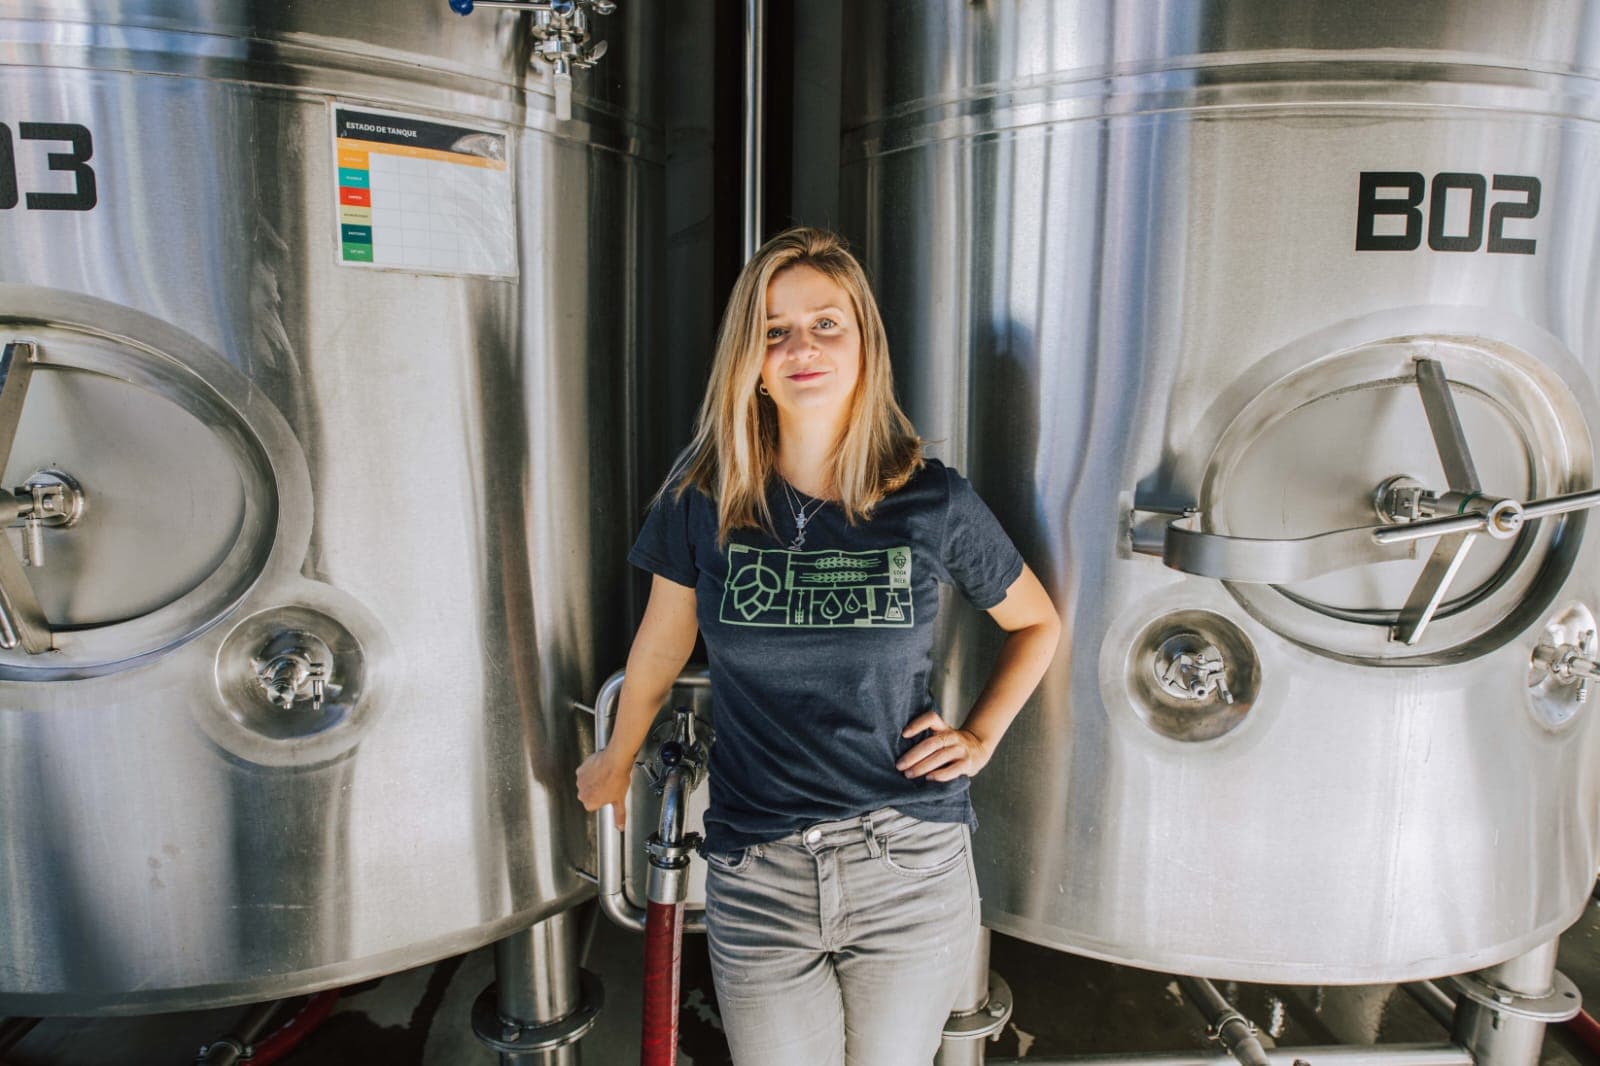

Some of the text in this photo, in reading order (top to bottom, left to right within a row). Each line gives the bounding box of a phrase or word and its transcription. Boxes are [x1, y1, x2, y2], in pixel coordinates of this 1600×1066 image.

[346, 121, 417, 138] ESTADO DE TANQUE
